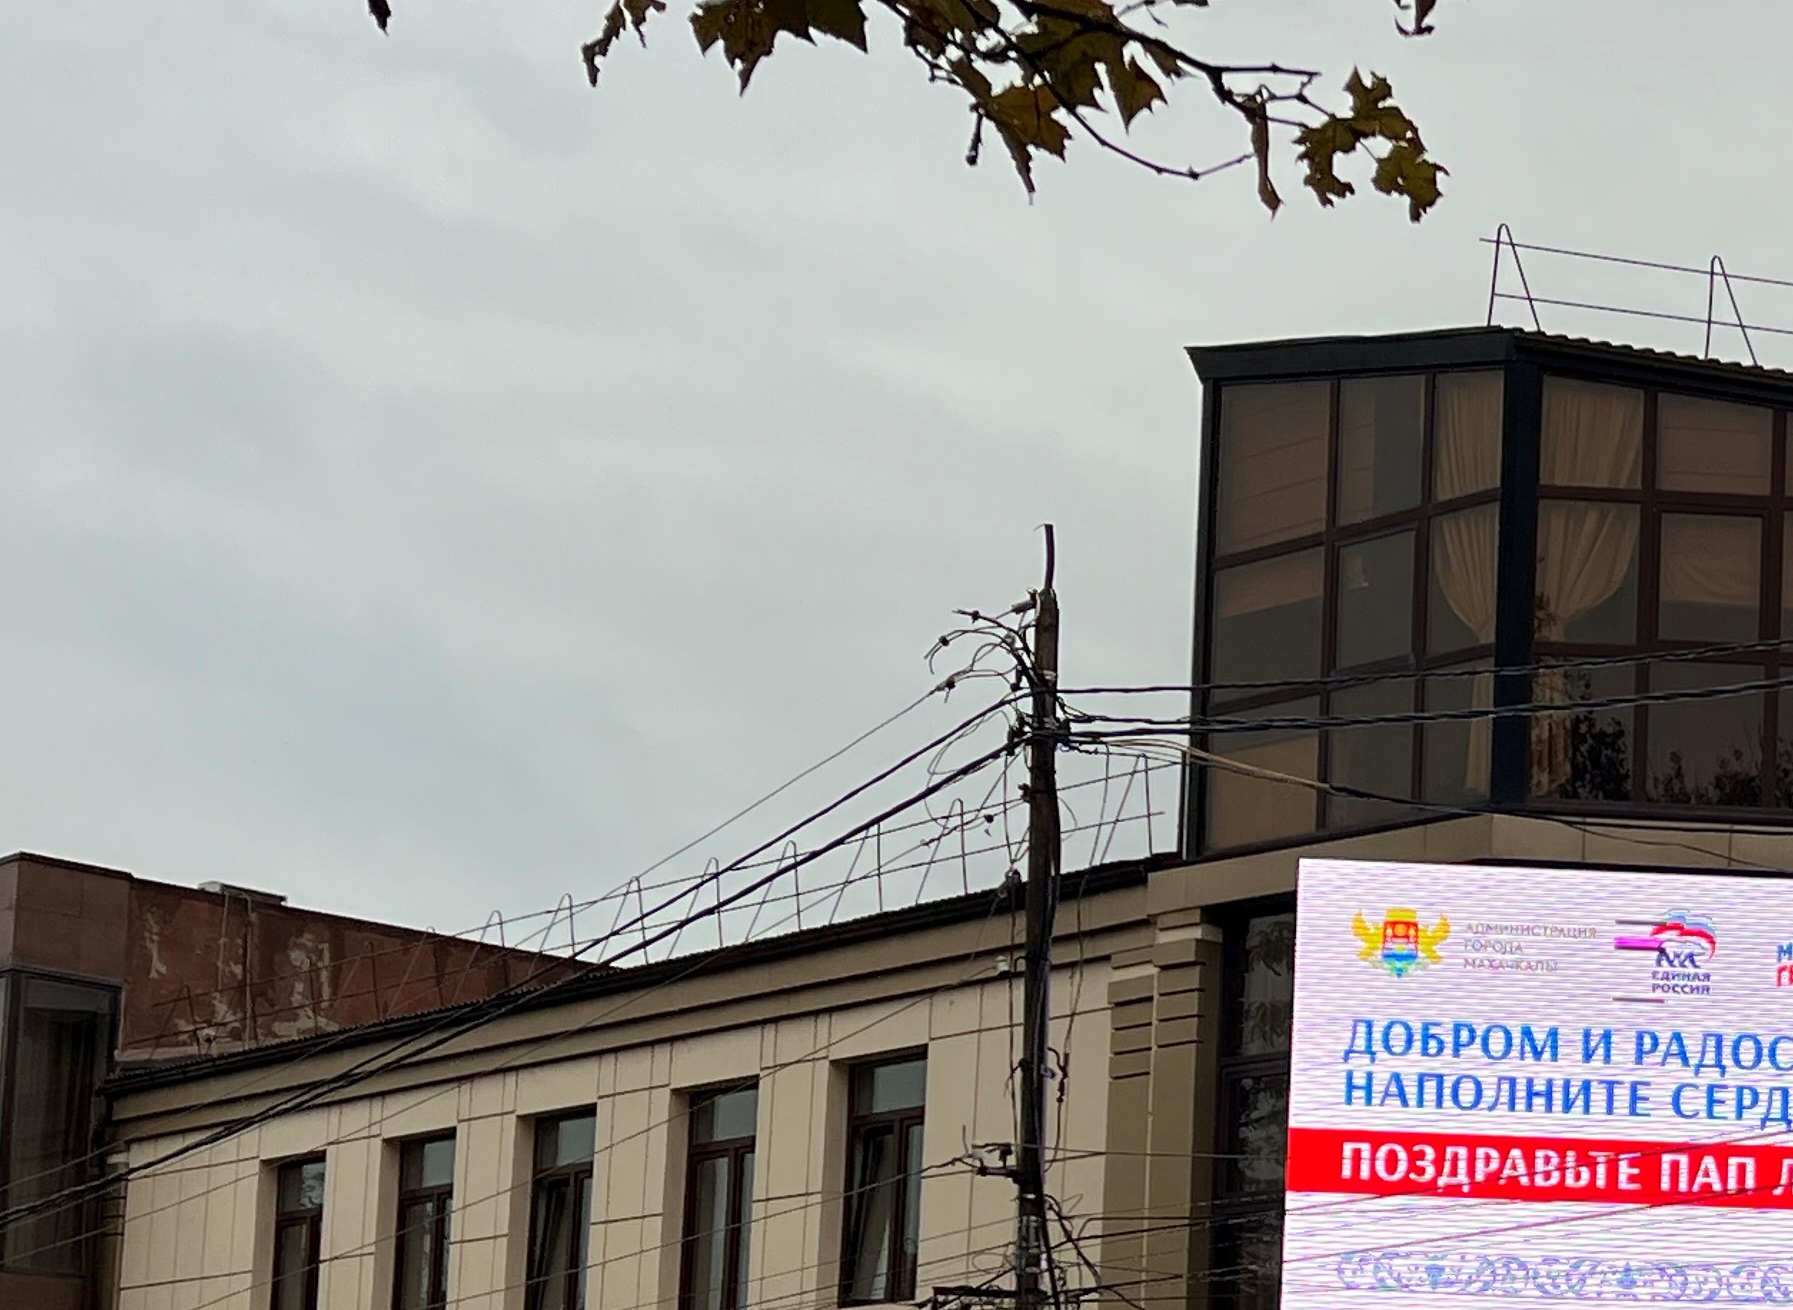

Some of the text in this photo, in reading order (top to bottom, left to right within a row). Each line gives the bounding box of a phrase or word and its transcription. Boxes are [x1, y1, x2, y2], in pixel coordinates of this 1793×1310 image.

[1466, 922, 1598, 939] АДМИНИСТРАЦИЯ
[1464, 939, 1524, 955] ГОРОДА
[1463, 957, 1560, 972] МАХАЧКАЛЫ
[1651, 970, 1712, 982] ЕДИНАЯ
[1651, 983, 1712, 995] РОССИЯ
[1342, 1018, 1560, 1065] ДОБРОМ
[1581, 1027, 1614, 1064] И
[1343, 1069, 1652, 1118] НАПОЛНИТЕ
[1340, 1140, 1643, 1193] ПОЗДРАВЬТЕ
[1659, 1152, 1757, 1195] ПАП
